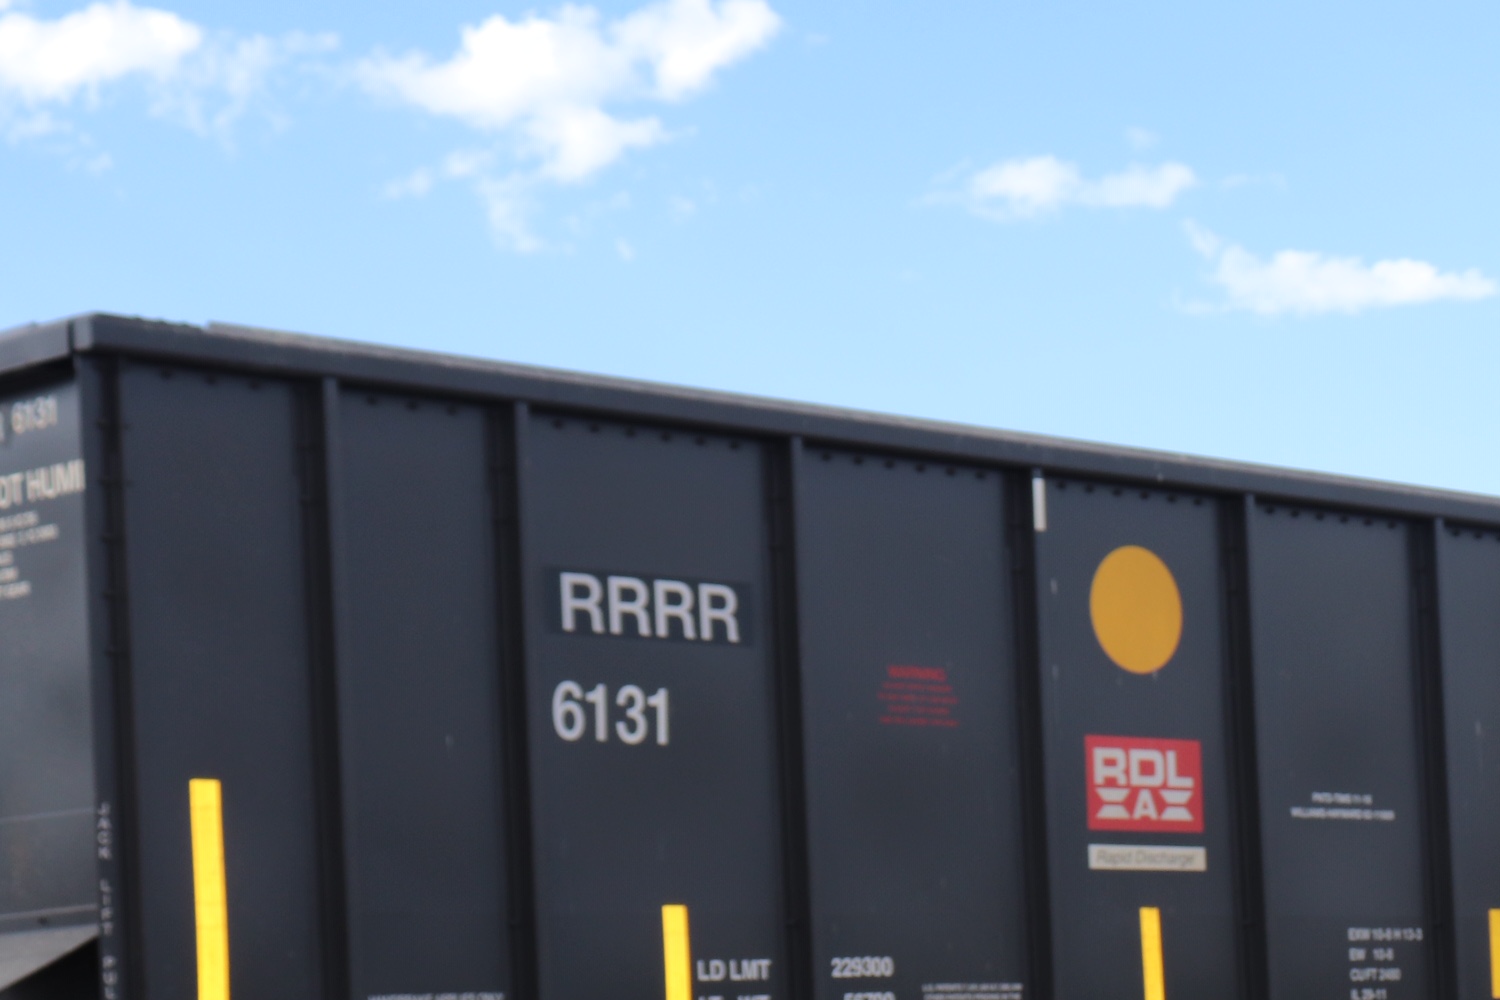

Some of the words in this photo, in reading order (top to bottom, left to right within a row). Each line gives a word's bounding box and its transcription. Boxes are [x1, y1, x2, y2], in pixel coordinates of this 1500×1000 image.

[0, 472, 25, 508] OT
[560, 572, 740, 643] RRRR
[552, 680, 670, 746] 6131
[697, 959, 726, 982] LD
[729, 959, 772, 982] LMT
